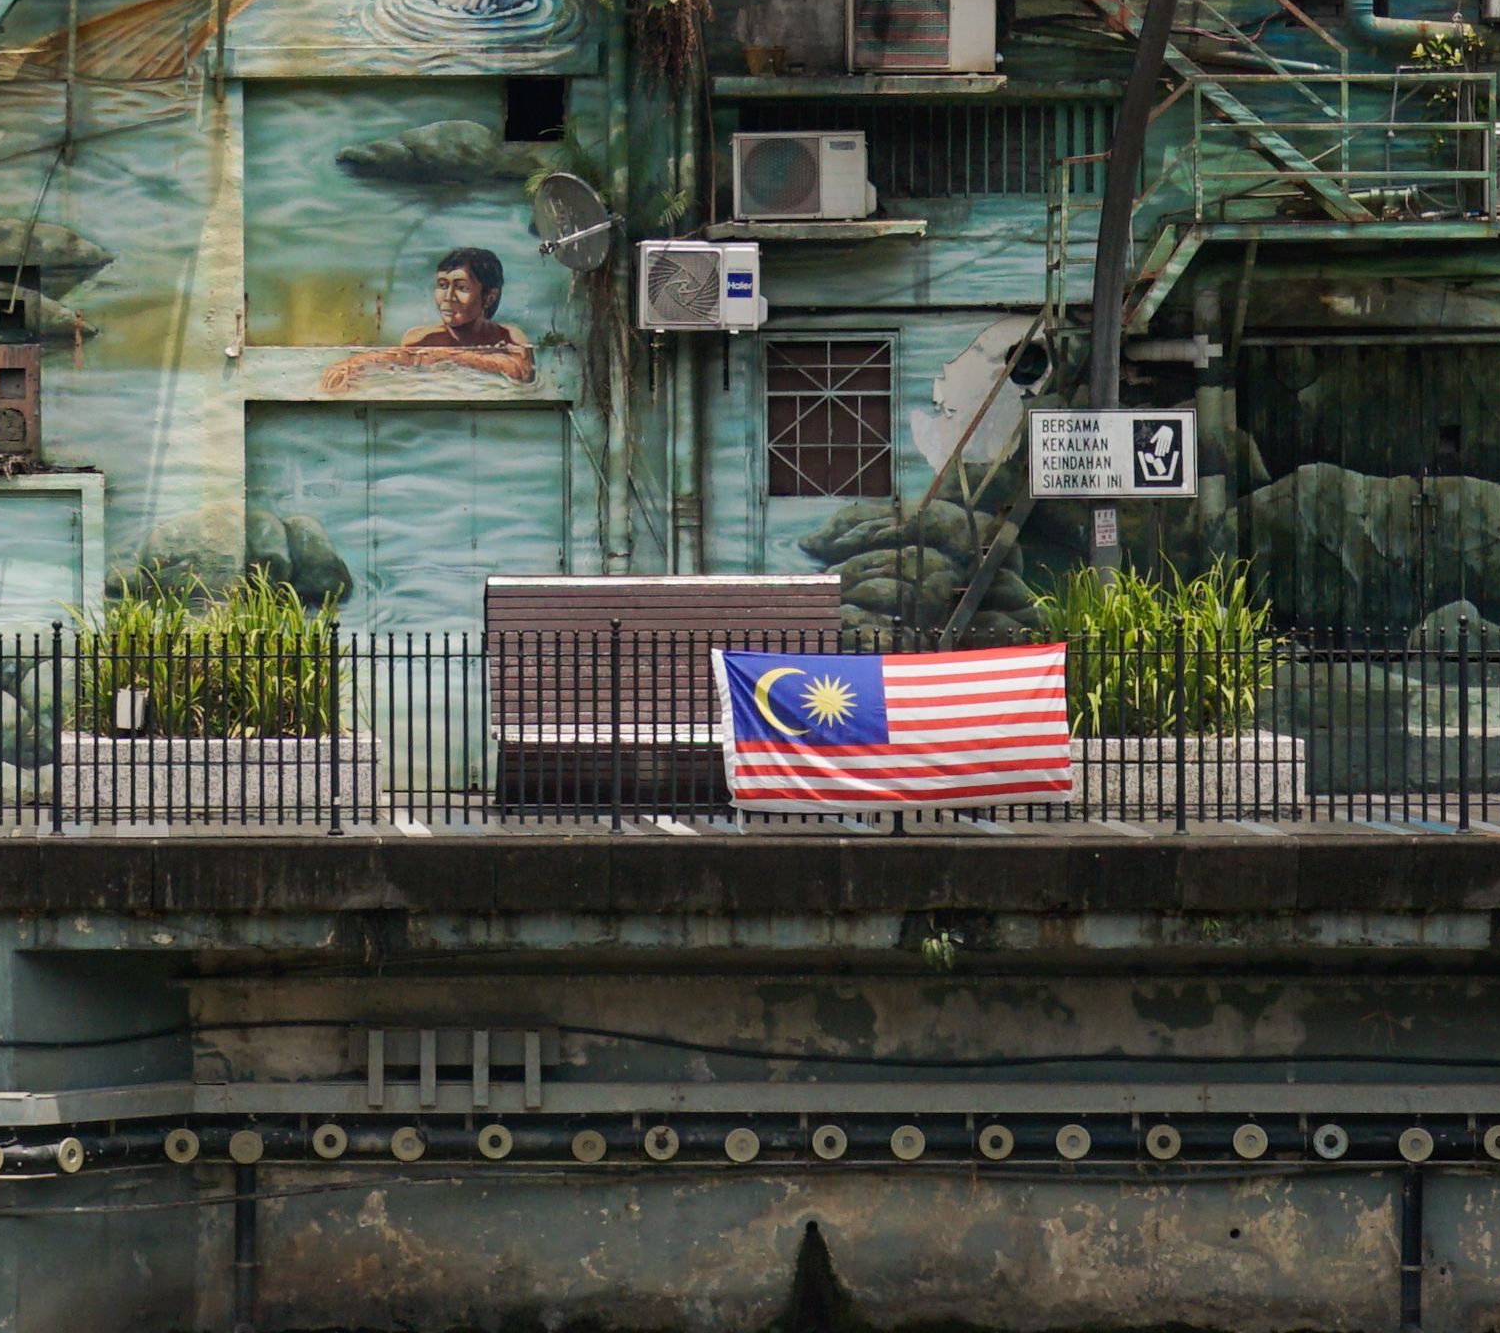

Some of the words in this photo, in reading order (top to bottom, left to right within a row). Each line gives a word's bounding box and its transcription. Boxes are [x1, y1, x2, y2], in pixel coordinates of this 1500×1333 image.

[727, 281, 752, 290] Haier
[1042, 419, 1100, 433] BERSAMA
[1042, 438, 1109, 452] KEKALKAN
[1042, 456, 1111, 470] KEINDAHAN
[1043, 474, 1100, 488] SIARKAKI
[1107, 474, 1122, 488] INI
